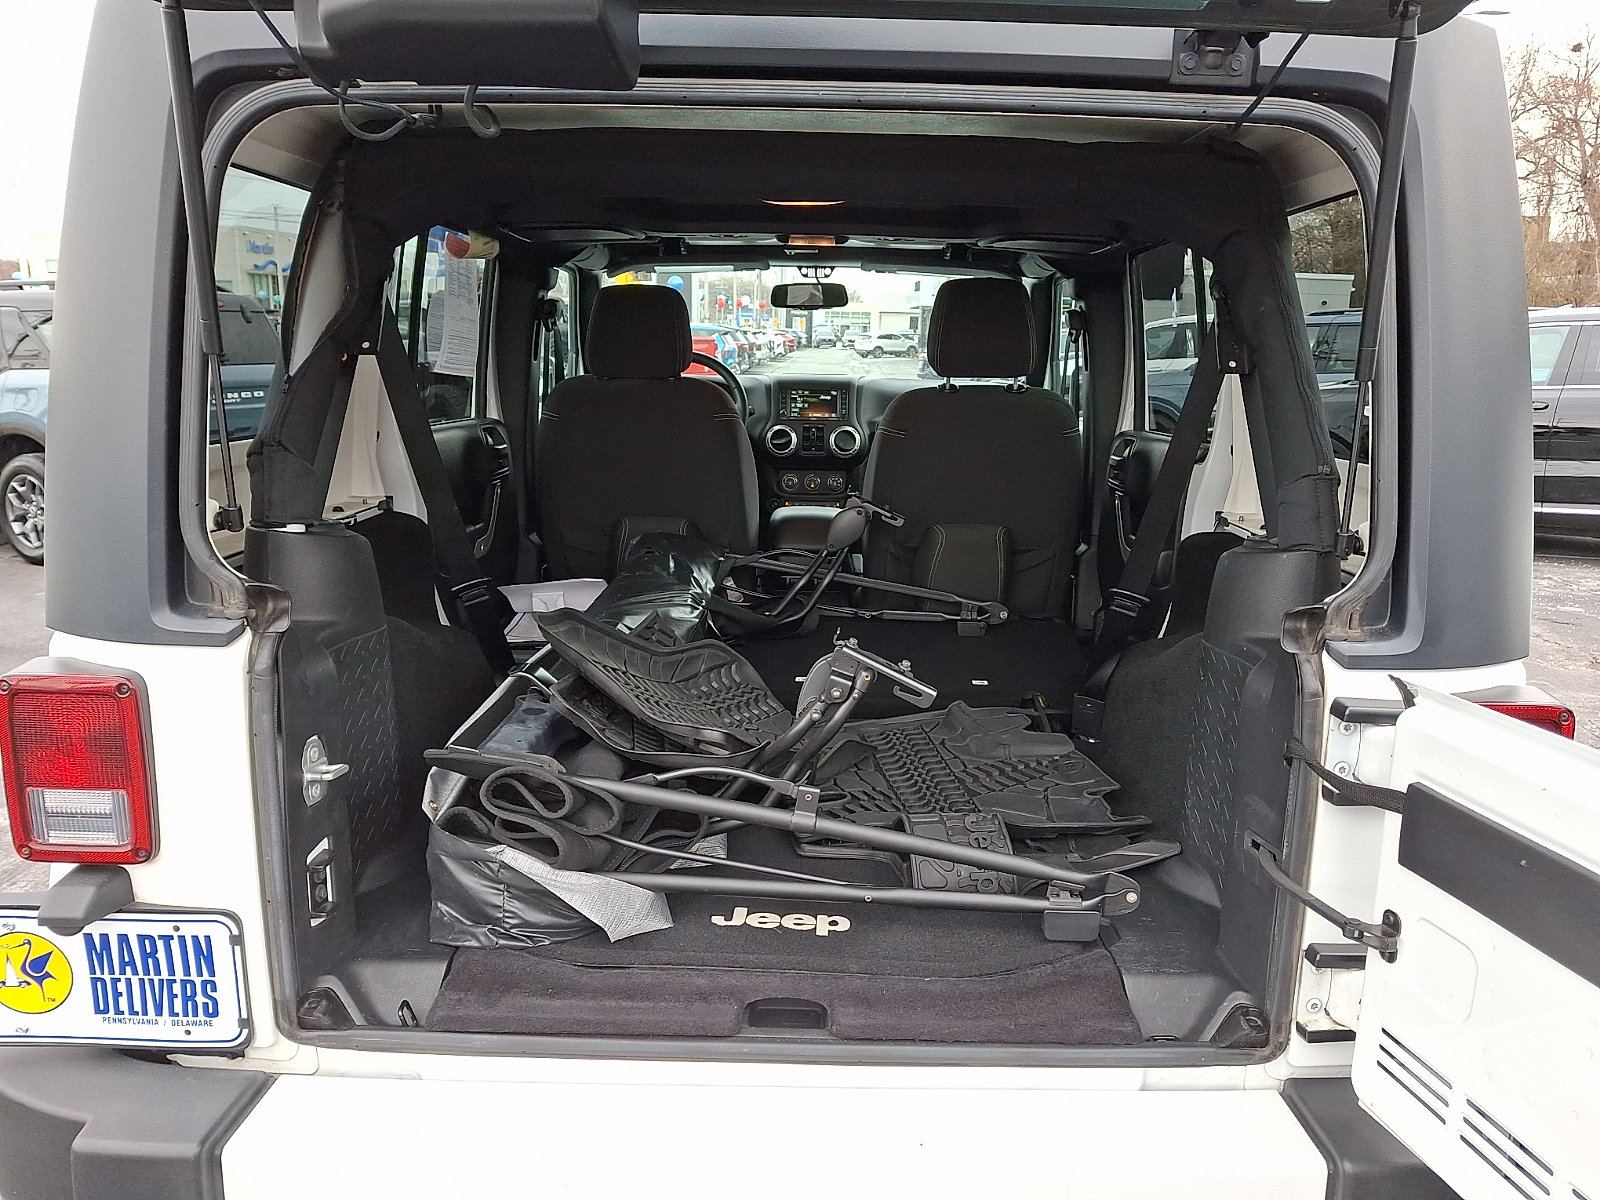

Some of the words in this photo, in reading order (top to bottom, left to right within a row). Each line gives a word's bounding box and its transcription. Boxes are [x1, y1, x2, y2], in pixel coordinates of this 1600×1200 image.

[710, 906, 851, 937] Jeep
[82, 932, 216, 978] MARTIN
[90, 977, 219, 1018] DELIVERS
[102, 1016, 159, 1026] PENNSYLVANIA
[171, 1019, 214, 1027] DELAWARE
